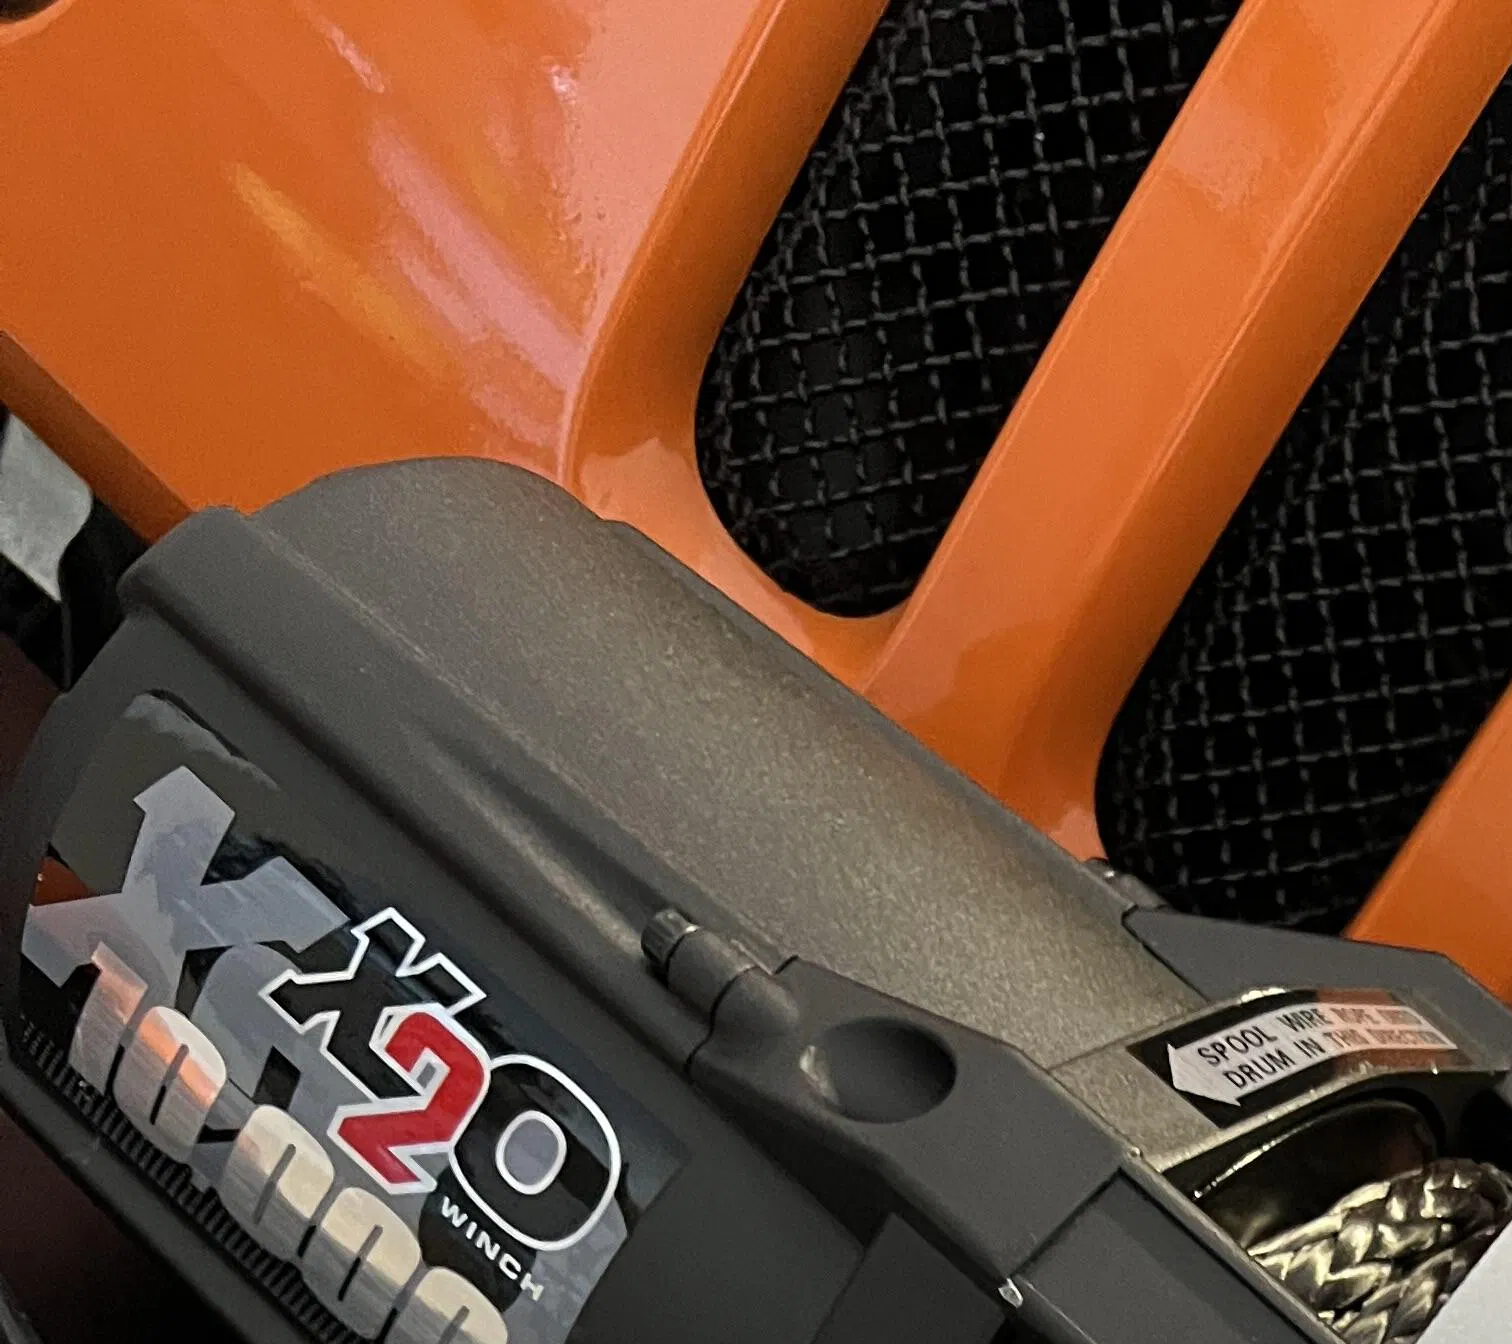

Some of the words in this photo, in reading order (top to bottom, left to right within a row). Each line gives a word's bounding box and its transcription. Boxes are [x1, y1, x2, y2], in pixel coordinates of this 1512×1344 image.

[259, 907, 621, 1251] X20
[1197, 1026, 1277, 1066] SPOOL
[1223, 1049, 1294, 1089] DRUM
[1293, 1037, 1326, 1058] IN
[441, 1197, 543, 1299] WINCH
